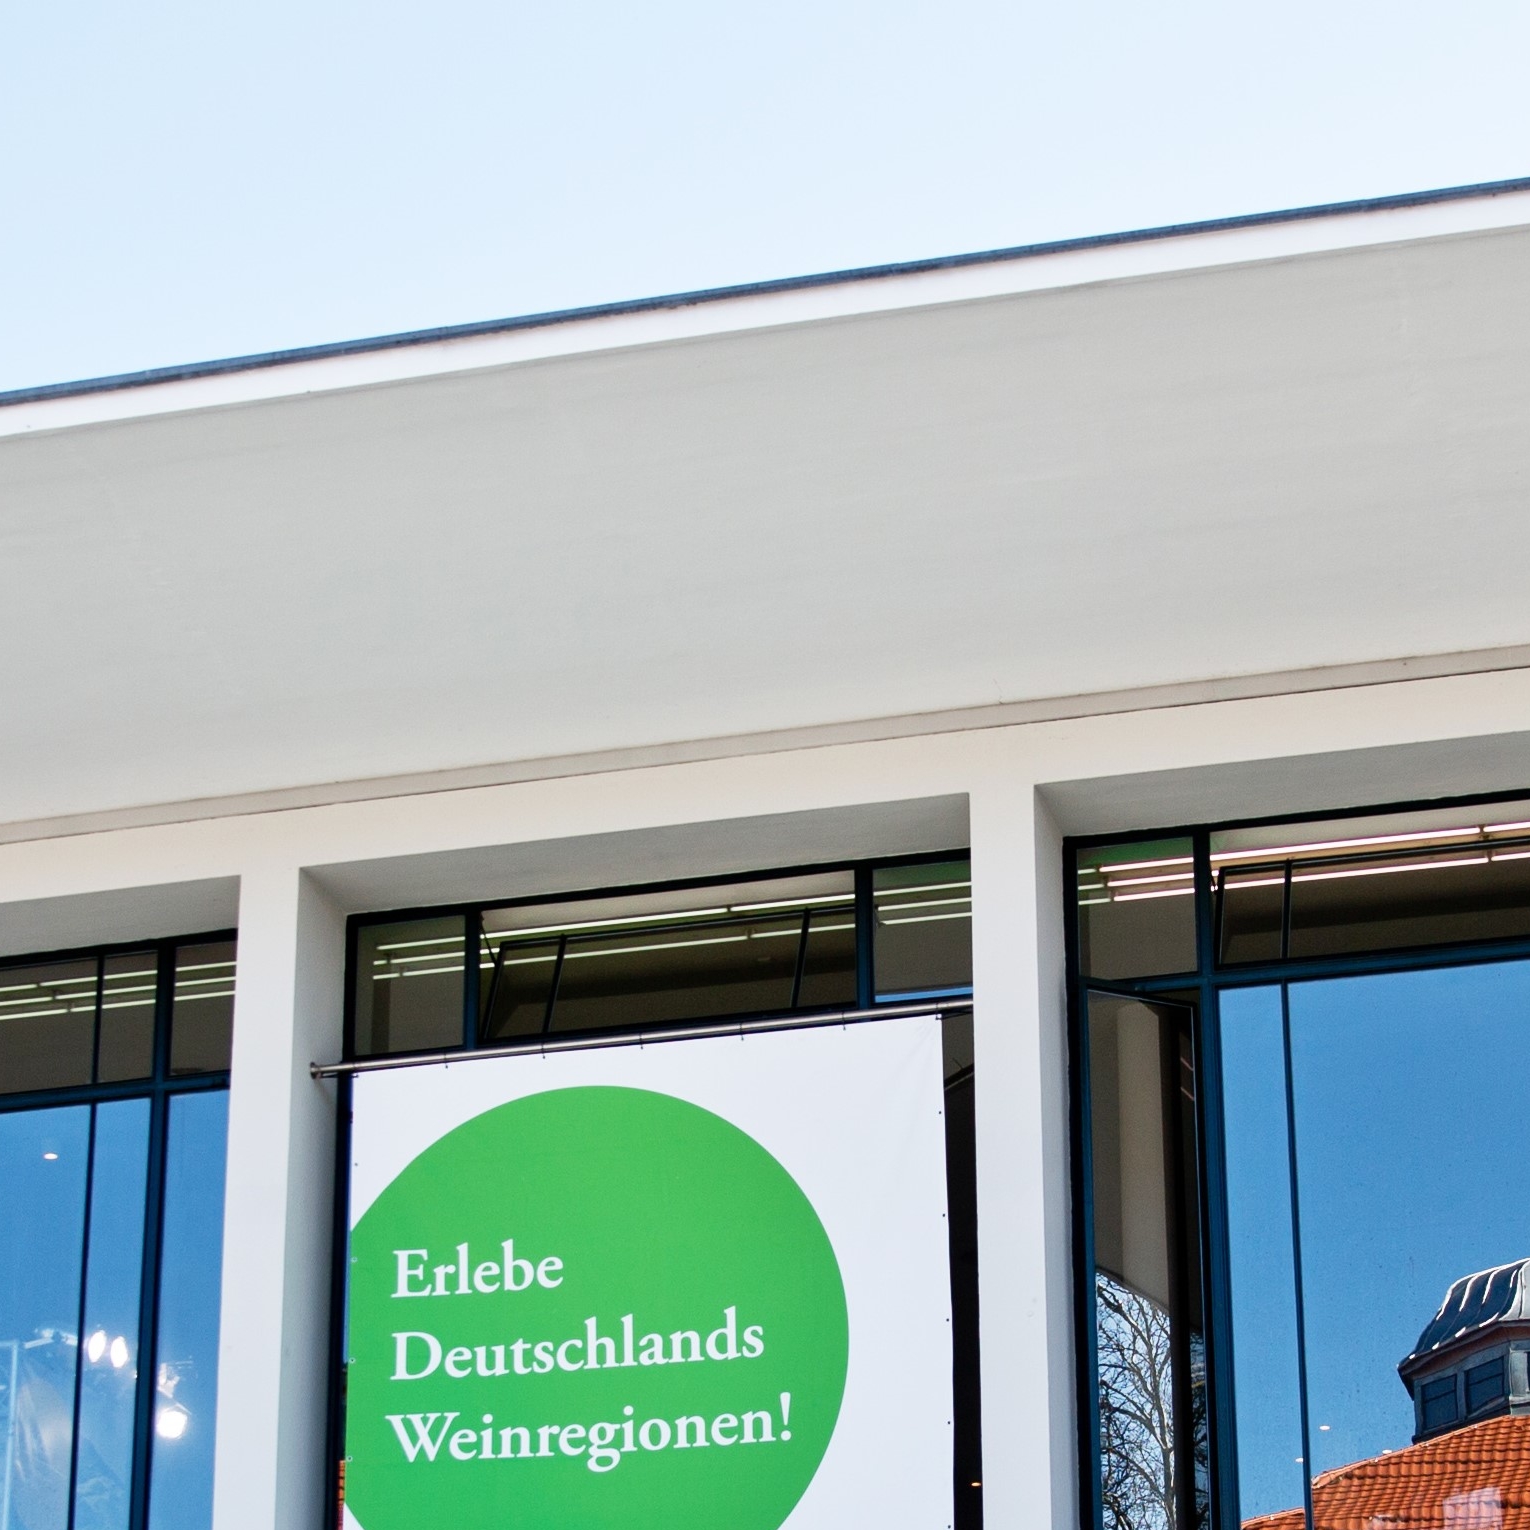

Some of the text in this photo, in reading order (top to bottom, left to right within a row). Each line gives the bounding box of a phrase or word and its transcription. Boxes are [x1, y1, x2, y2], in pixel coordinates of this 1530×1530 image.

[390, 1238, 564, 1298] Erlebe
[389, 1306, 765, 1380] Deutschlands
[385, 1391, 793, 1472] Weinregionen!
